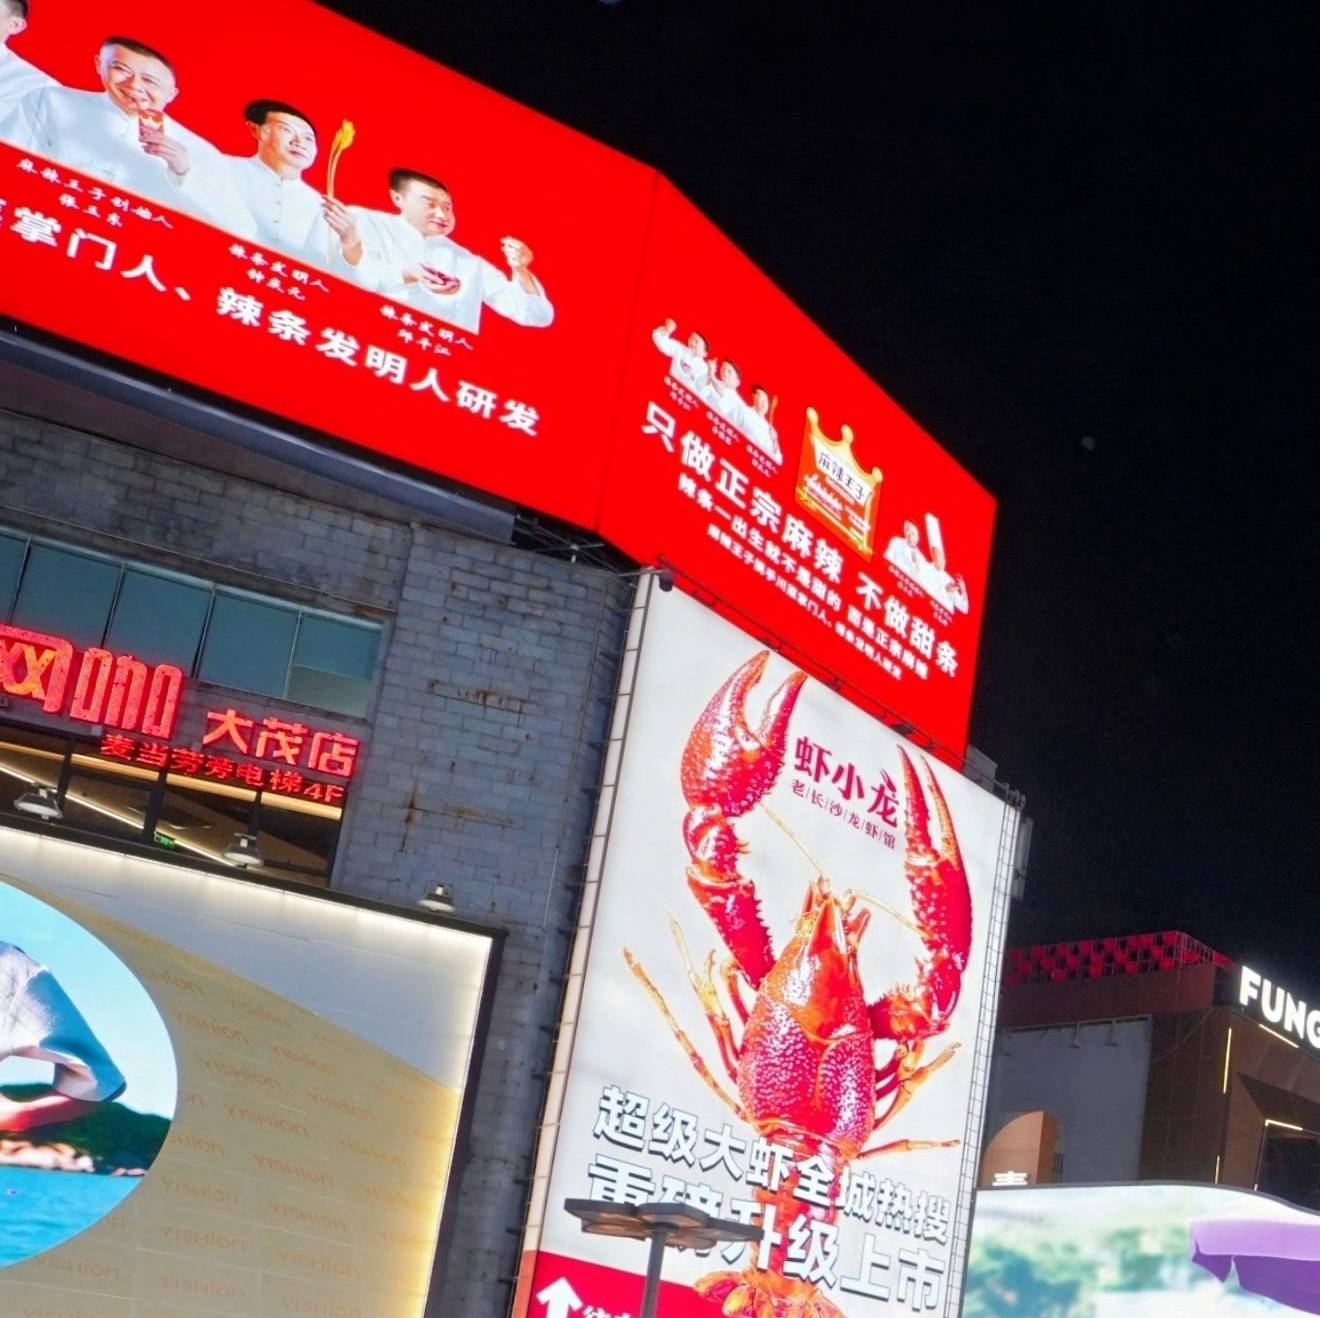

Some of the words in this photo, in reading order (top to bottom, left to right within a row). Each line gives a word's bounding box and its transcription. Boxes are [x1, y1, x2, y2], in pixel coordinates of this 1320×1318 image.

[641, 401, 846, 584] 只做正宗麻辣
[856, 572, 958, 677] 不做甜条
[101, 734, 346, 803] 麦当劳旁电梯4F
[203, 709, 360, 778] 大茂店
[794, 735, 900, 830] 虾小龙
[593, 1084, 954, 1247] 超级大虾全城热搜
